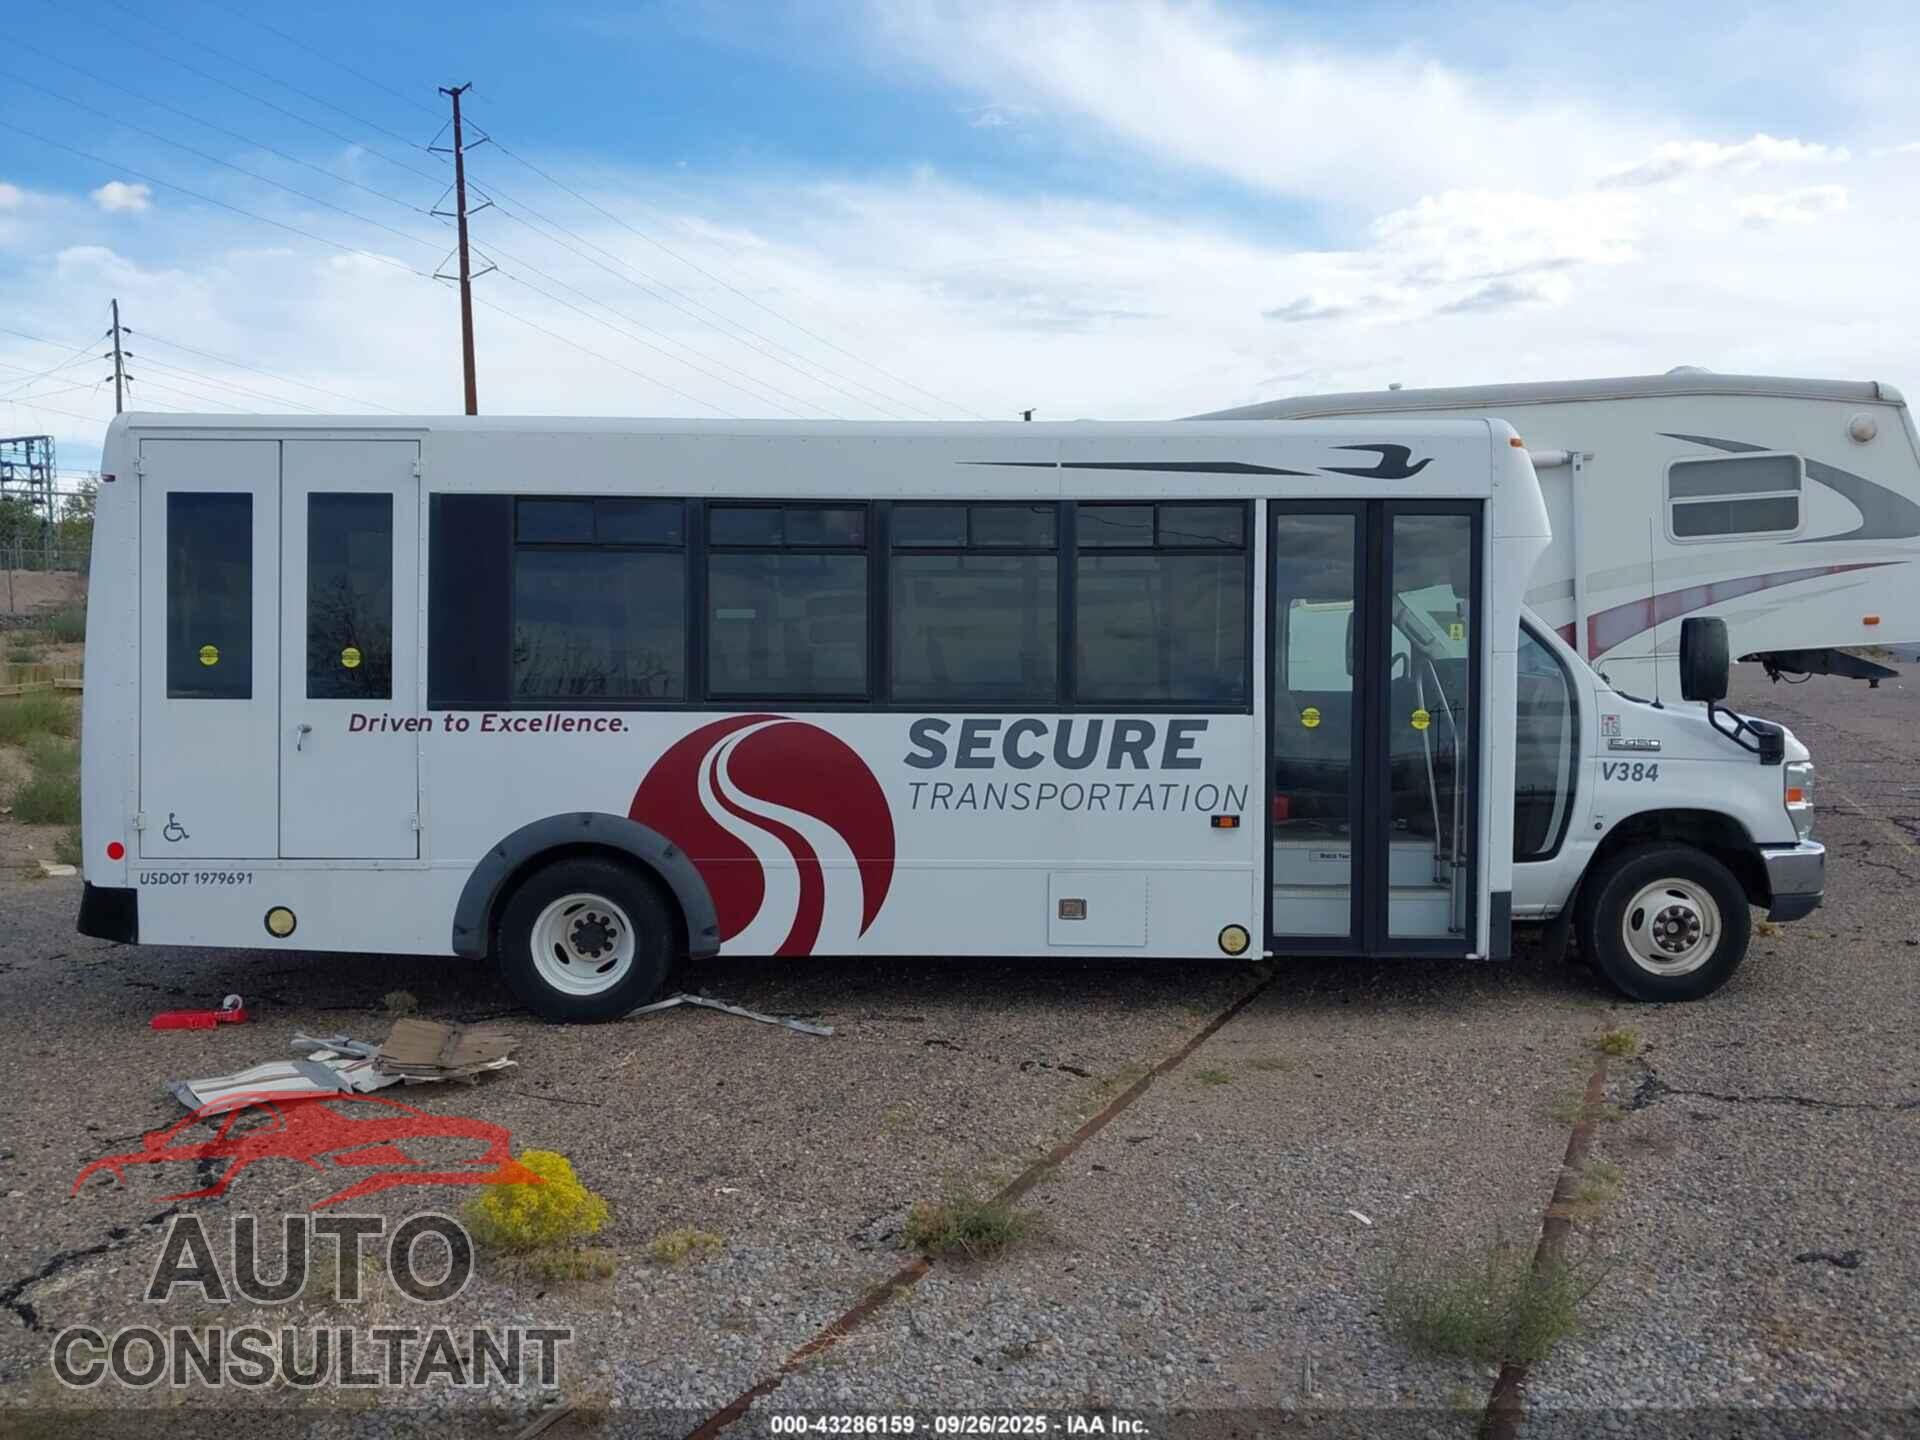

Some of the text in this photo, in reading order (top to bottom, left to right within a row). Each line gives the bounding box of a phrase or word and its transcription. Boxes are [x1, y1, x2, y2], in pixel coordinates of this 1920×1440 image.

[348, 713, 630, 732] Driven to Excellence.
[903, 717, 1209, 771] SECURE
[1602, 761, 1660, 782] V384
[909, 781, 1249, 813] TRANSPORTATION
[139, 872, 253, 885] USDOT 1979691
